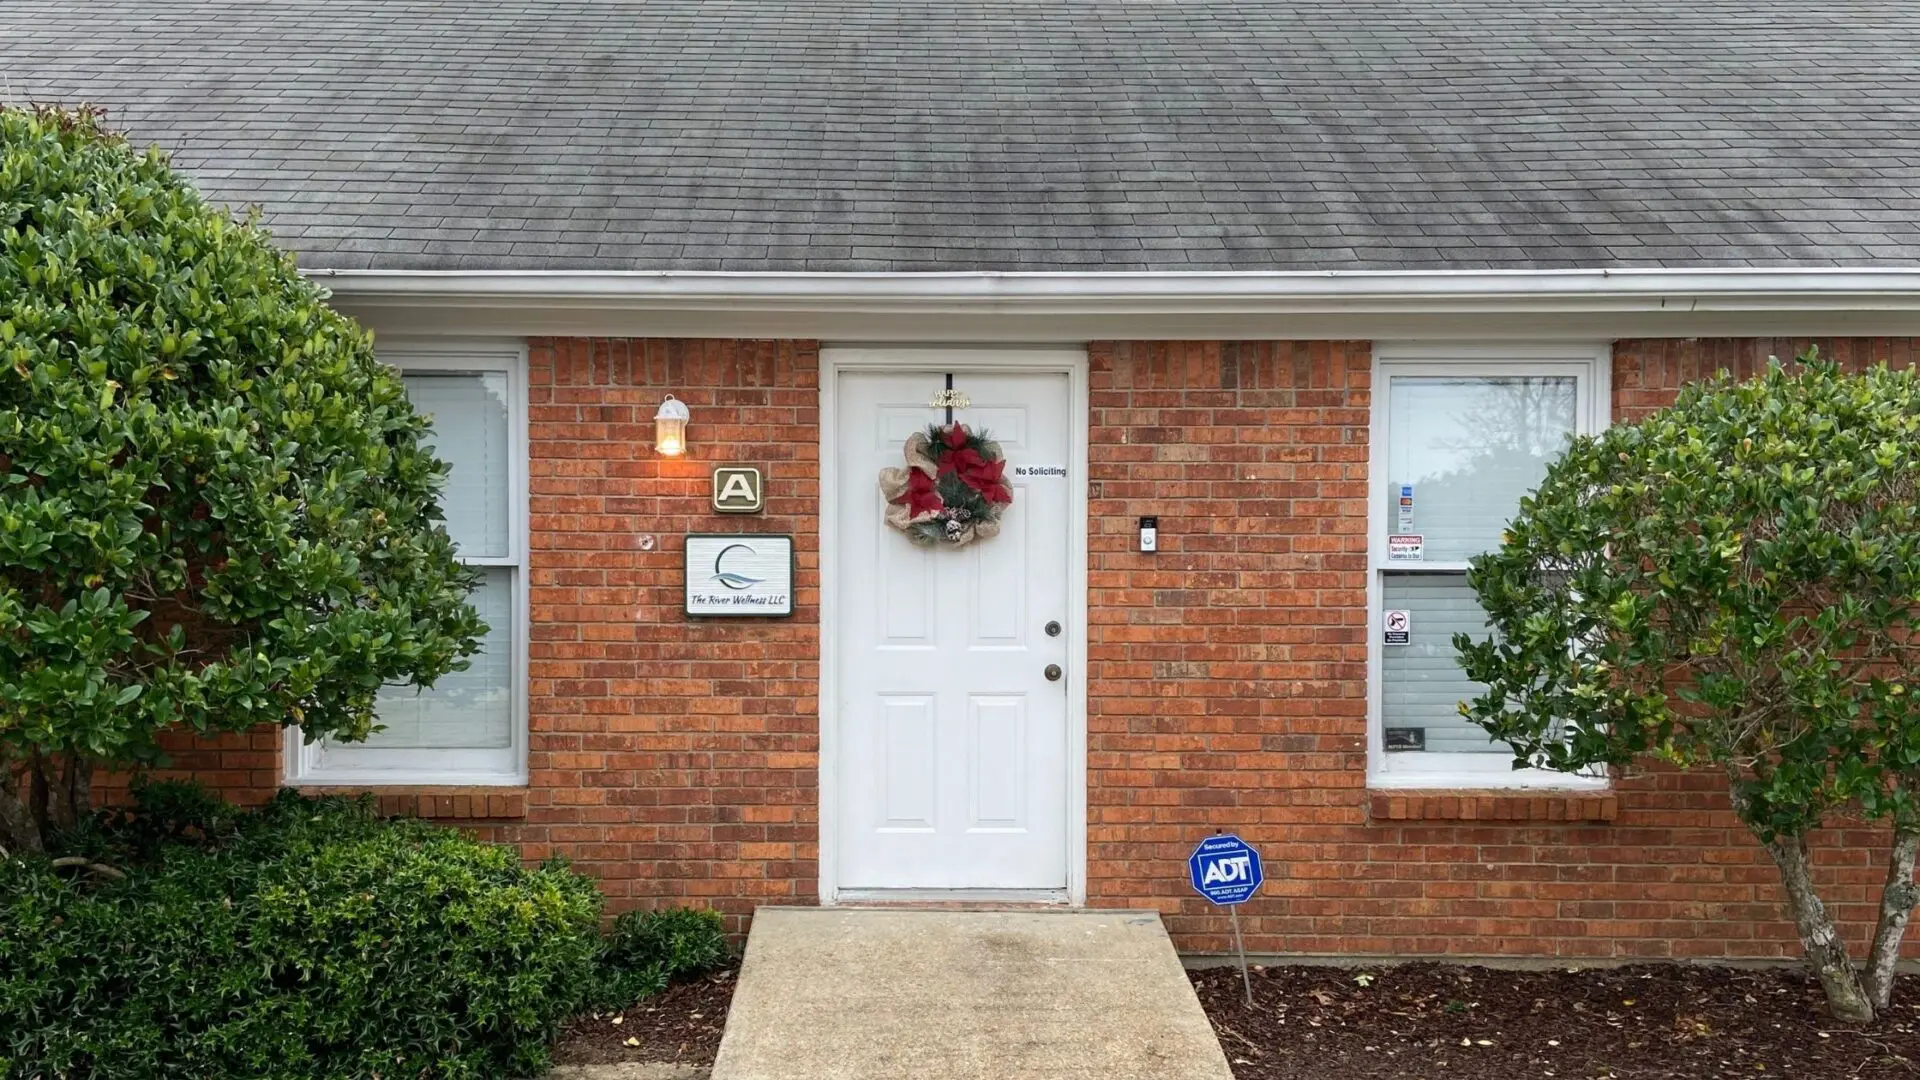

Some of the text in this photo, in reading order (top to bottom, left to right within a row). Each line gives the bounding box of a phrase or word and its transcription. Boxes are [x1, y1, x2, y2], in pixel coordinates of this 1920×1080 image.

[1015, 467, 1066, 477] No Soliciting
[718, 474, 756, 501] A
[692, 594, 785, 605] The River Wellness LLC
[1204, 841, 1239, 850] Secured by
[1204, 857, 1248, 884] ADT
